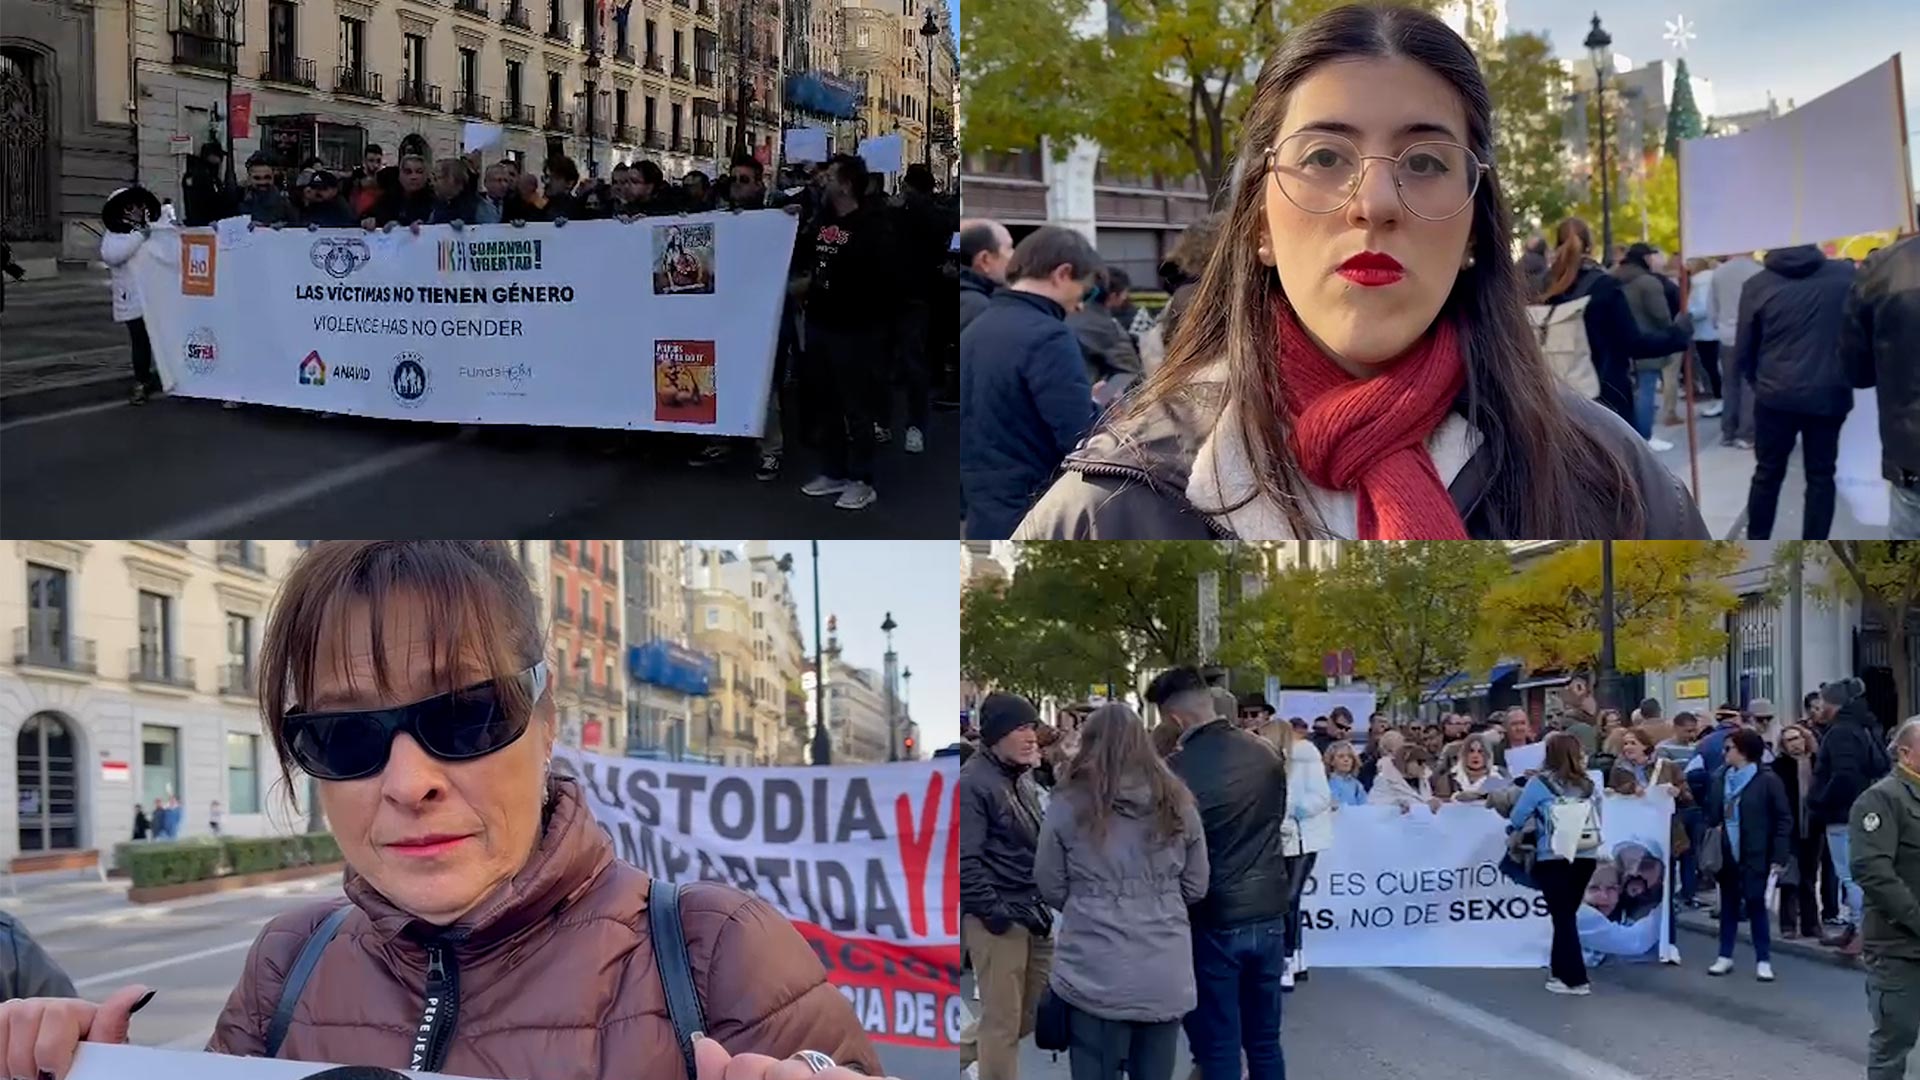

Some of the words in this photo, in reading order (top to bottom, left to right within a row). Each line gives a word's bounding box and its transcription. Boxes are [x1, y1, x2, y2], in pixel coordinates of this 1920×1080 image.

[296, 284, 325, 301] LAS
[327, 282, 391, 303] VÍCTIMAS
[393, 286, 414, 303] NO
[417, 286, 488, 304] TIENEN
[492, 282, 574, 303] GÉNERO
[313, 315, 379, 334] VIOLENCE
[380, 319, 409, 336] HAS
[412, 320, 437, 337] NO
[441, 319, 523, 337] GENDER
[333, 365, 371, 382] ANAVID
[1330, 872, 1366, 896] ES
[1350, 906, 1394, 928] NO
[1404, 902, 1440, 926] DE
[1449, 896, 1549, 922] SEXOS
[893, 988, 937, 1040] DE
